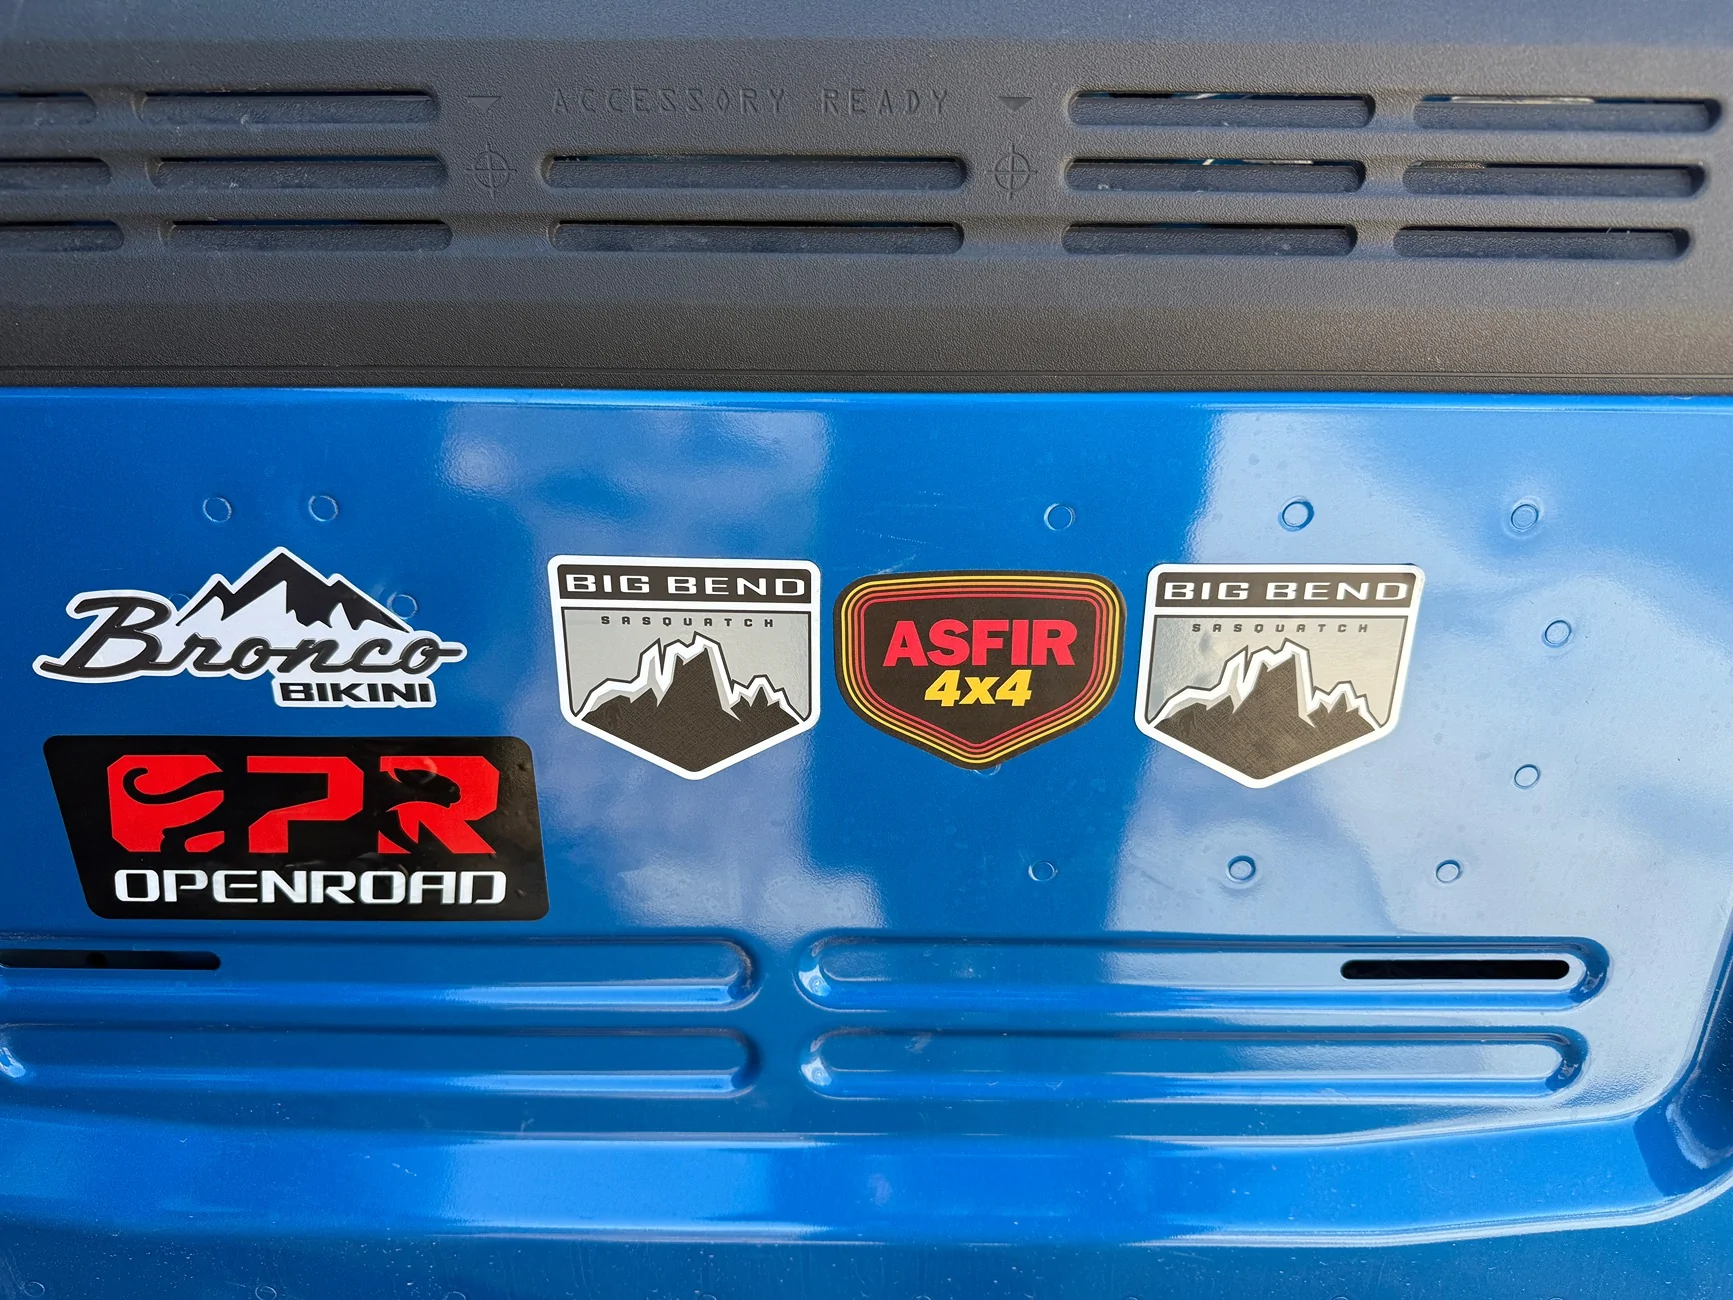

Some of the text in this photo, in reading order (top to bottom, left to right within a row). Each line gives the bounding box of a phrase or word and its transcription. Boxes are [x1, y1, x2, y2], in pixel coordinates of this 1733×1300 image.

[551, 87, 948, 115] ACCESSORY READY
[566, 574, 805, 596] BIG BEND
[1163, 582, 1408, 601] BIG BEND
[600, 615, 774, 628] SASQUATCH
[1191, 623, 1369, 633] SASQUATCH
[40, 596, 464, 679] Bronco
[883, 618, 1078, 667] ASFIR
[279, 682, 432, 703] BIKINI
[924, 669, 1033, 707] 4x4
[114, 869, 507, 905] OPENROAD
